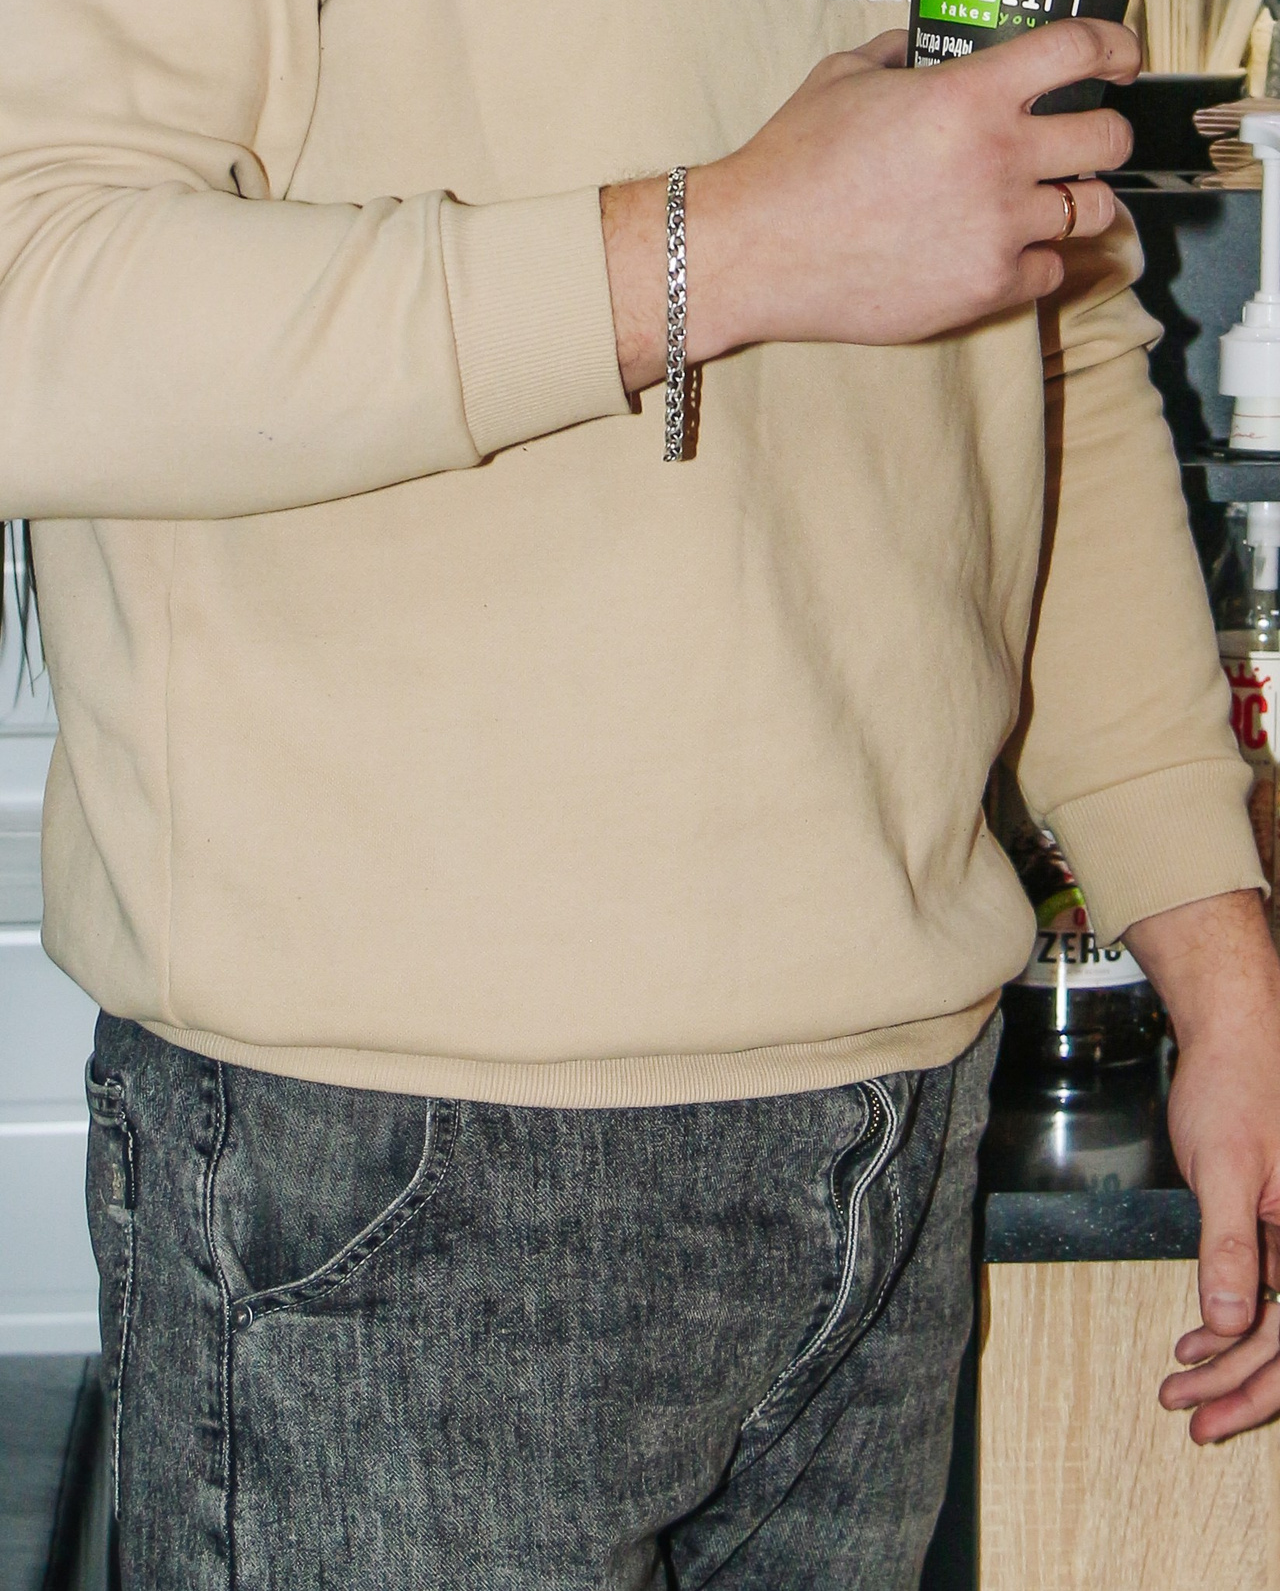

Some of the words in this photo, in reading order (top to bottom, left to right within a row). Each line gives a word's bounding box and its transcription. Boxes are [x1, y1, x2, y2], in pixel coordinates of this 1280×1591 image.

[941, 1, 991, 22] takes
[998, 12, 1036, 28] you
[941, 35, 973, 58] рады
